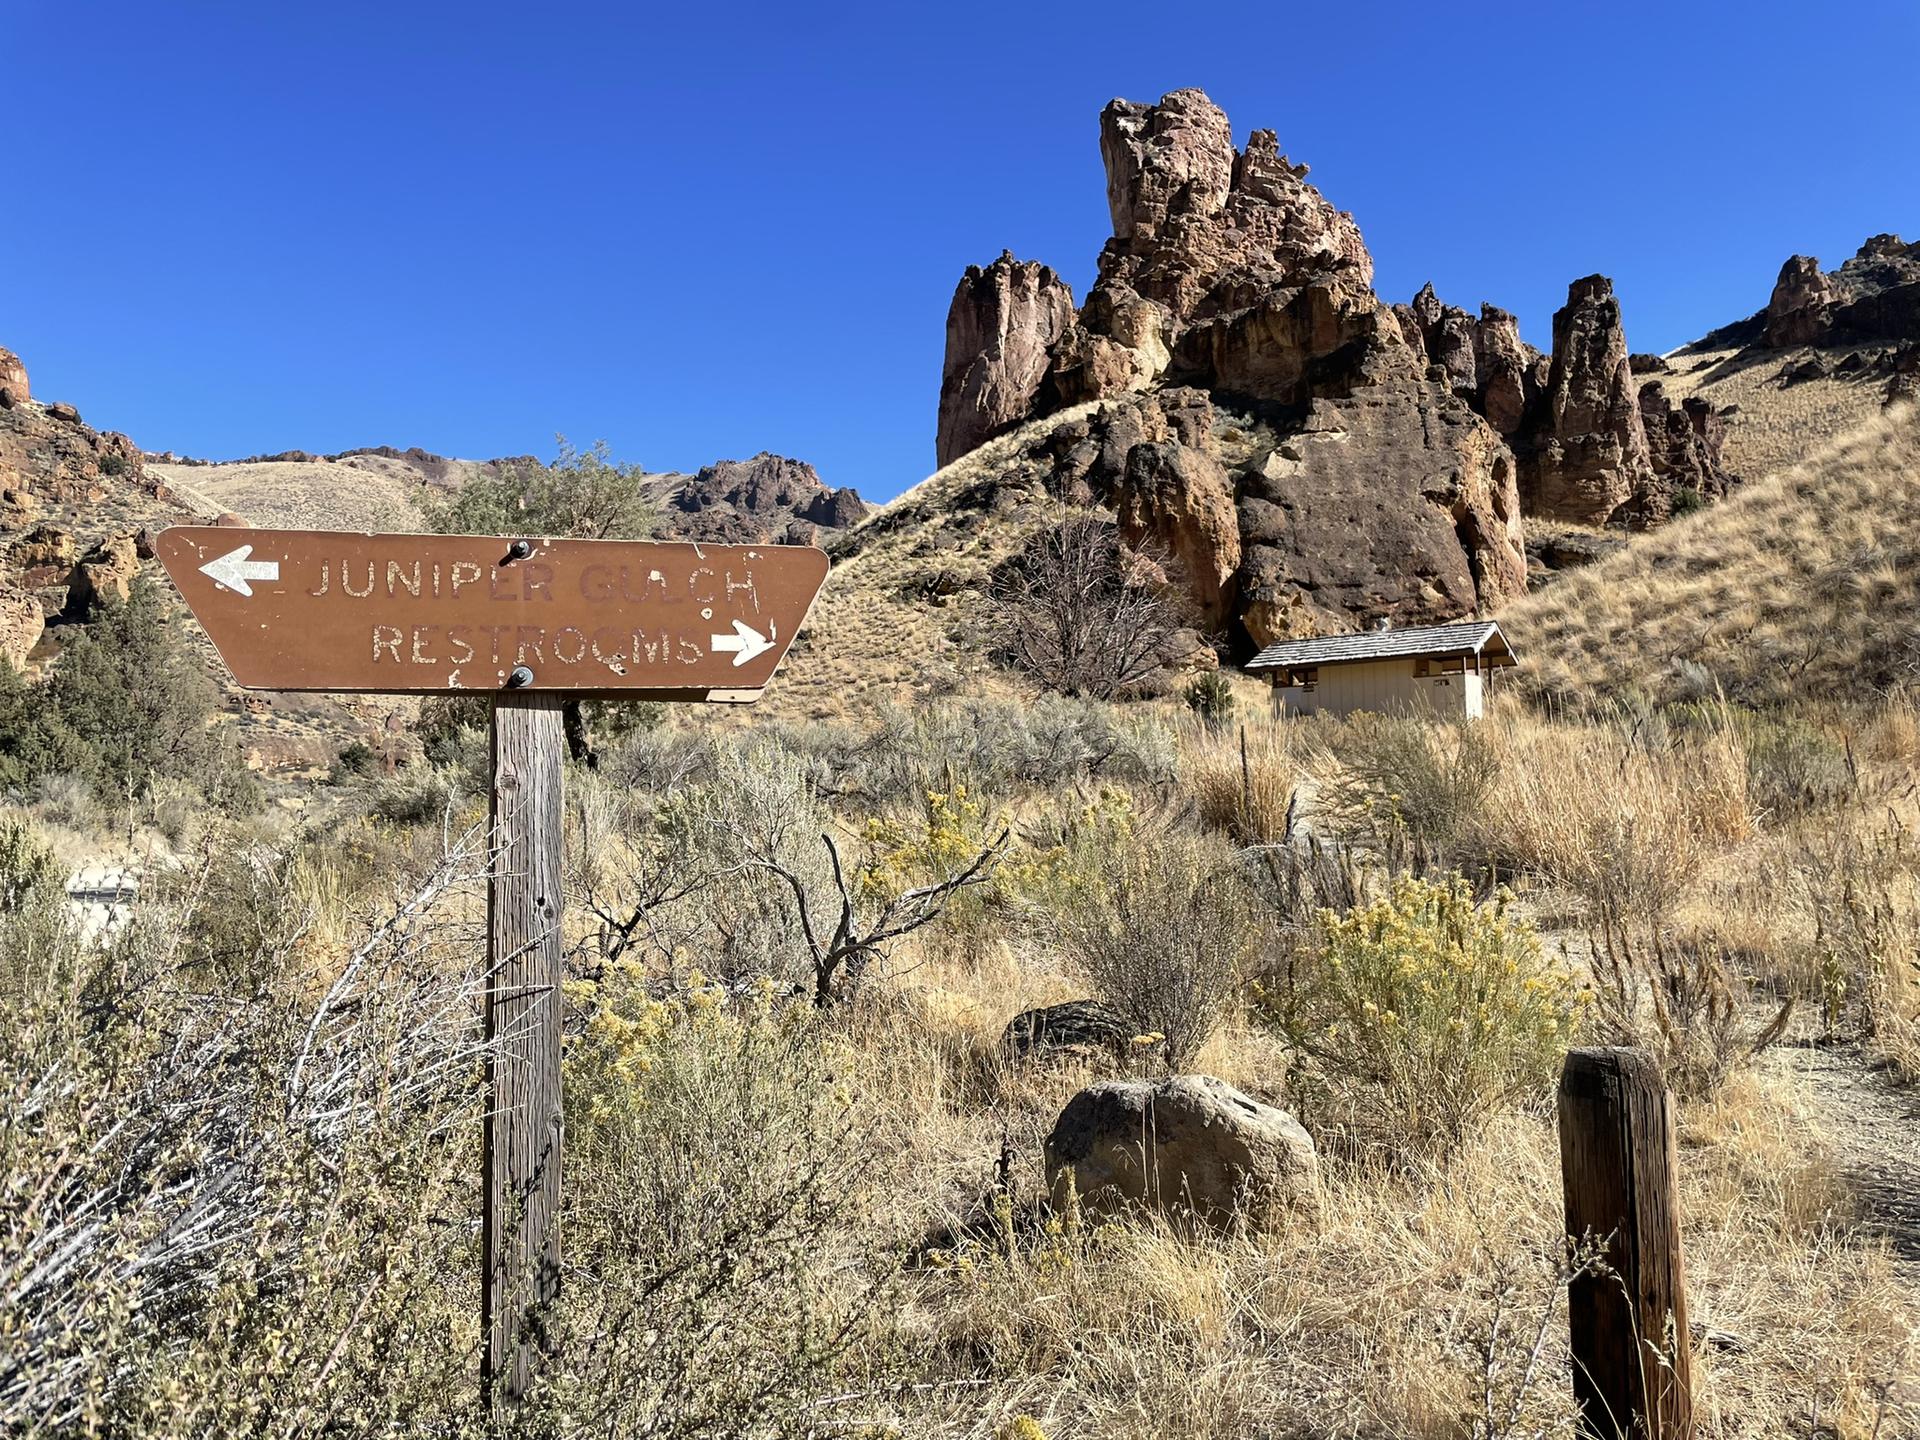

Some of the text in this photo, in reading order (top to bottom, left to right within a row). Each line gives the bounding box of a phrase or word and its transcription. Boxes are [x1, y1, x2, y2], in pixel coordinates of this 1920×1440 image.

[305, 559, 755, 604] JUNIPER GULCH
[371, 622, 703, 665] RESTROOMS
